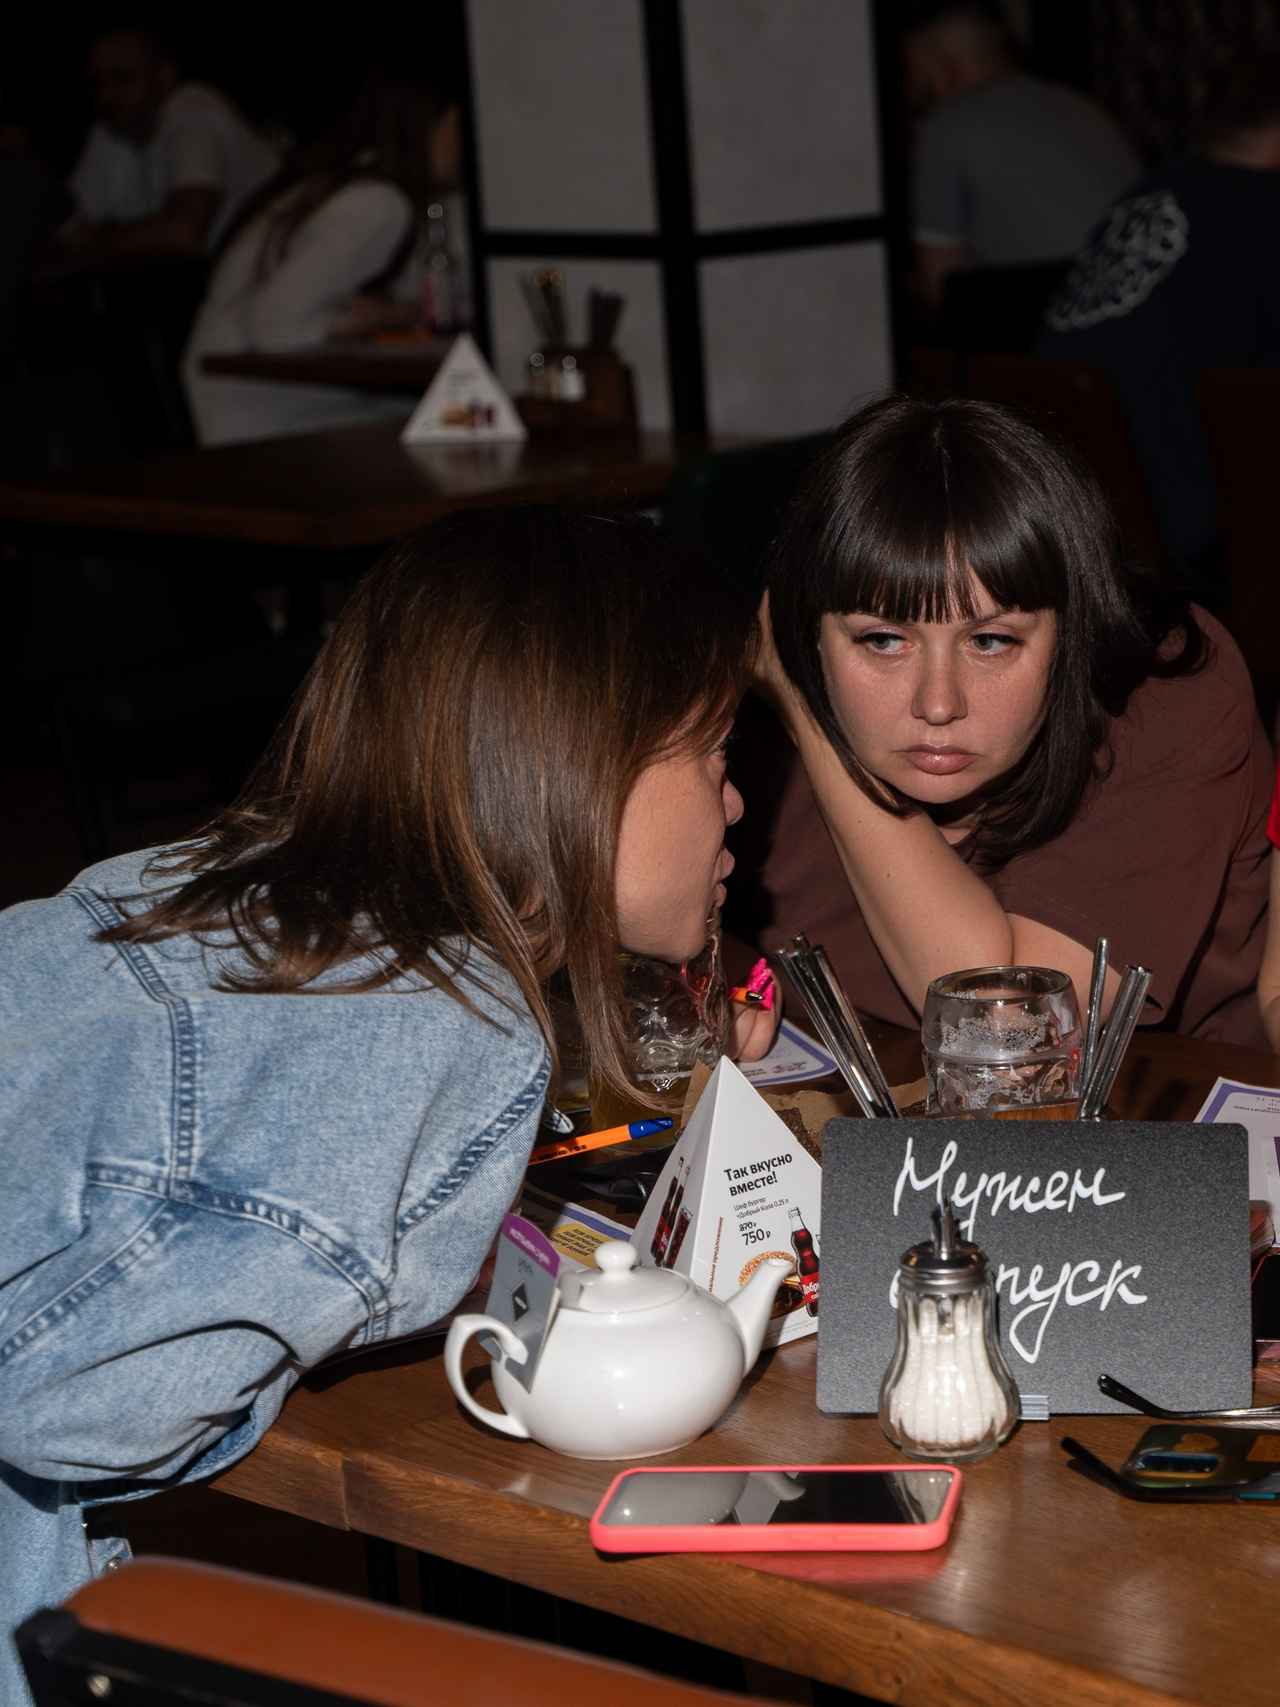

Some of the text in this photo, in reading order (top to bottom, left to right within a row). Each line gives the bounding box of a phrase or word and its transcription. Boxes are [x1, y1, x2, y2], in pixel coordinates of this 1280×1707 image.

[724, 1153, 793, 1182] Так вкусно
[729, 1171, 778, 1196] вместе!
[734, 1196, 766, 1211] Шеф бургер
[760, 1203, 774, 1212] Кола
[742, 1228, 765, 1246] 750
[802, 1281, 819, 1296] Добр
